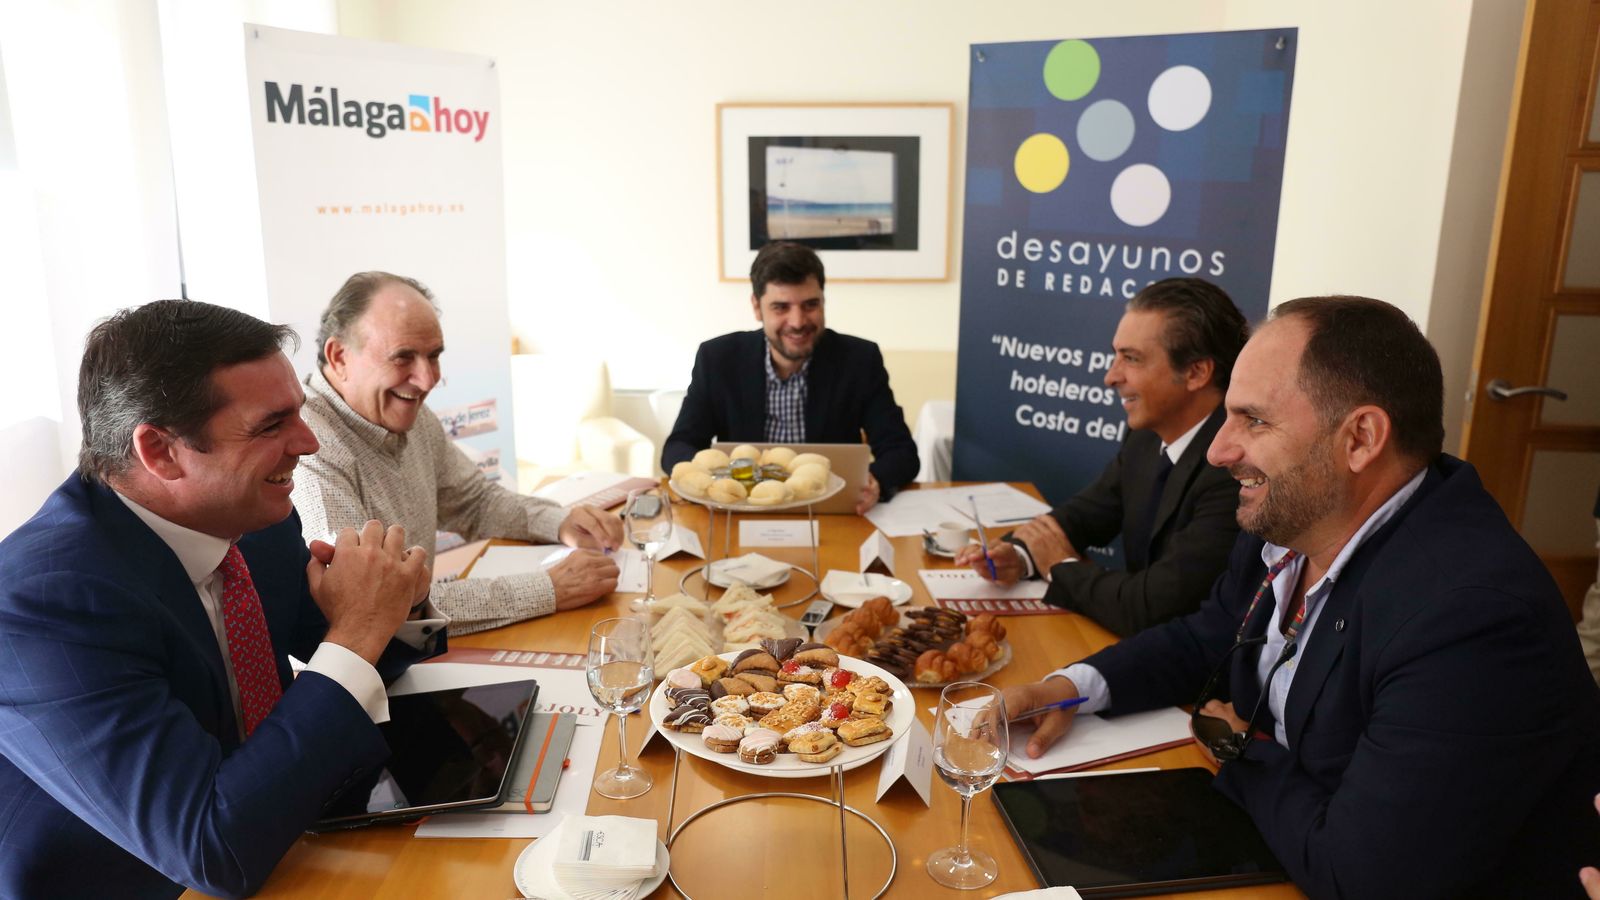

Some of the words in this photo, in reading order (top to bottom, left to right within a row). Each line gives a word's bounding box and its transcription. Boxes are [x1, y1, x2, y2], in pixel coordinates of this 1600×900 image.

[264, 81, 406, 138] Málaga
[433, 96, 490, 143] hoy
[316, 203, 465, 216] www.malagahoy.es
[996, 230, 1226, 276] desayunos
[997, 268, 1025, 288] DE
[1044, 272, 1157, 299] REDAC
[1088, 351, 1115, 373] pr
[1009, 370, 1115, 406] hoteleros
[1015, 404, 1080, 434] Costa
[1085, 416, 1125, 442] del
[543, 703, 605, 717] JOLY
